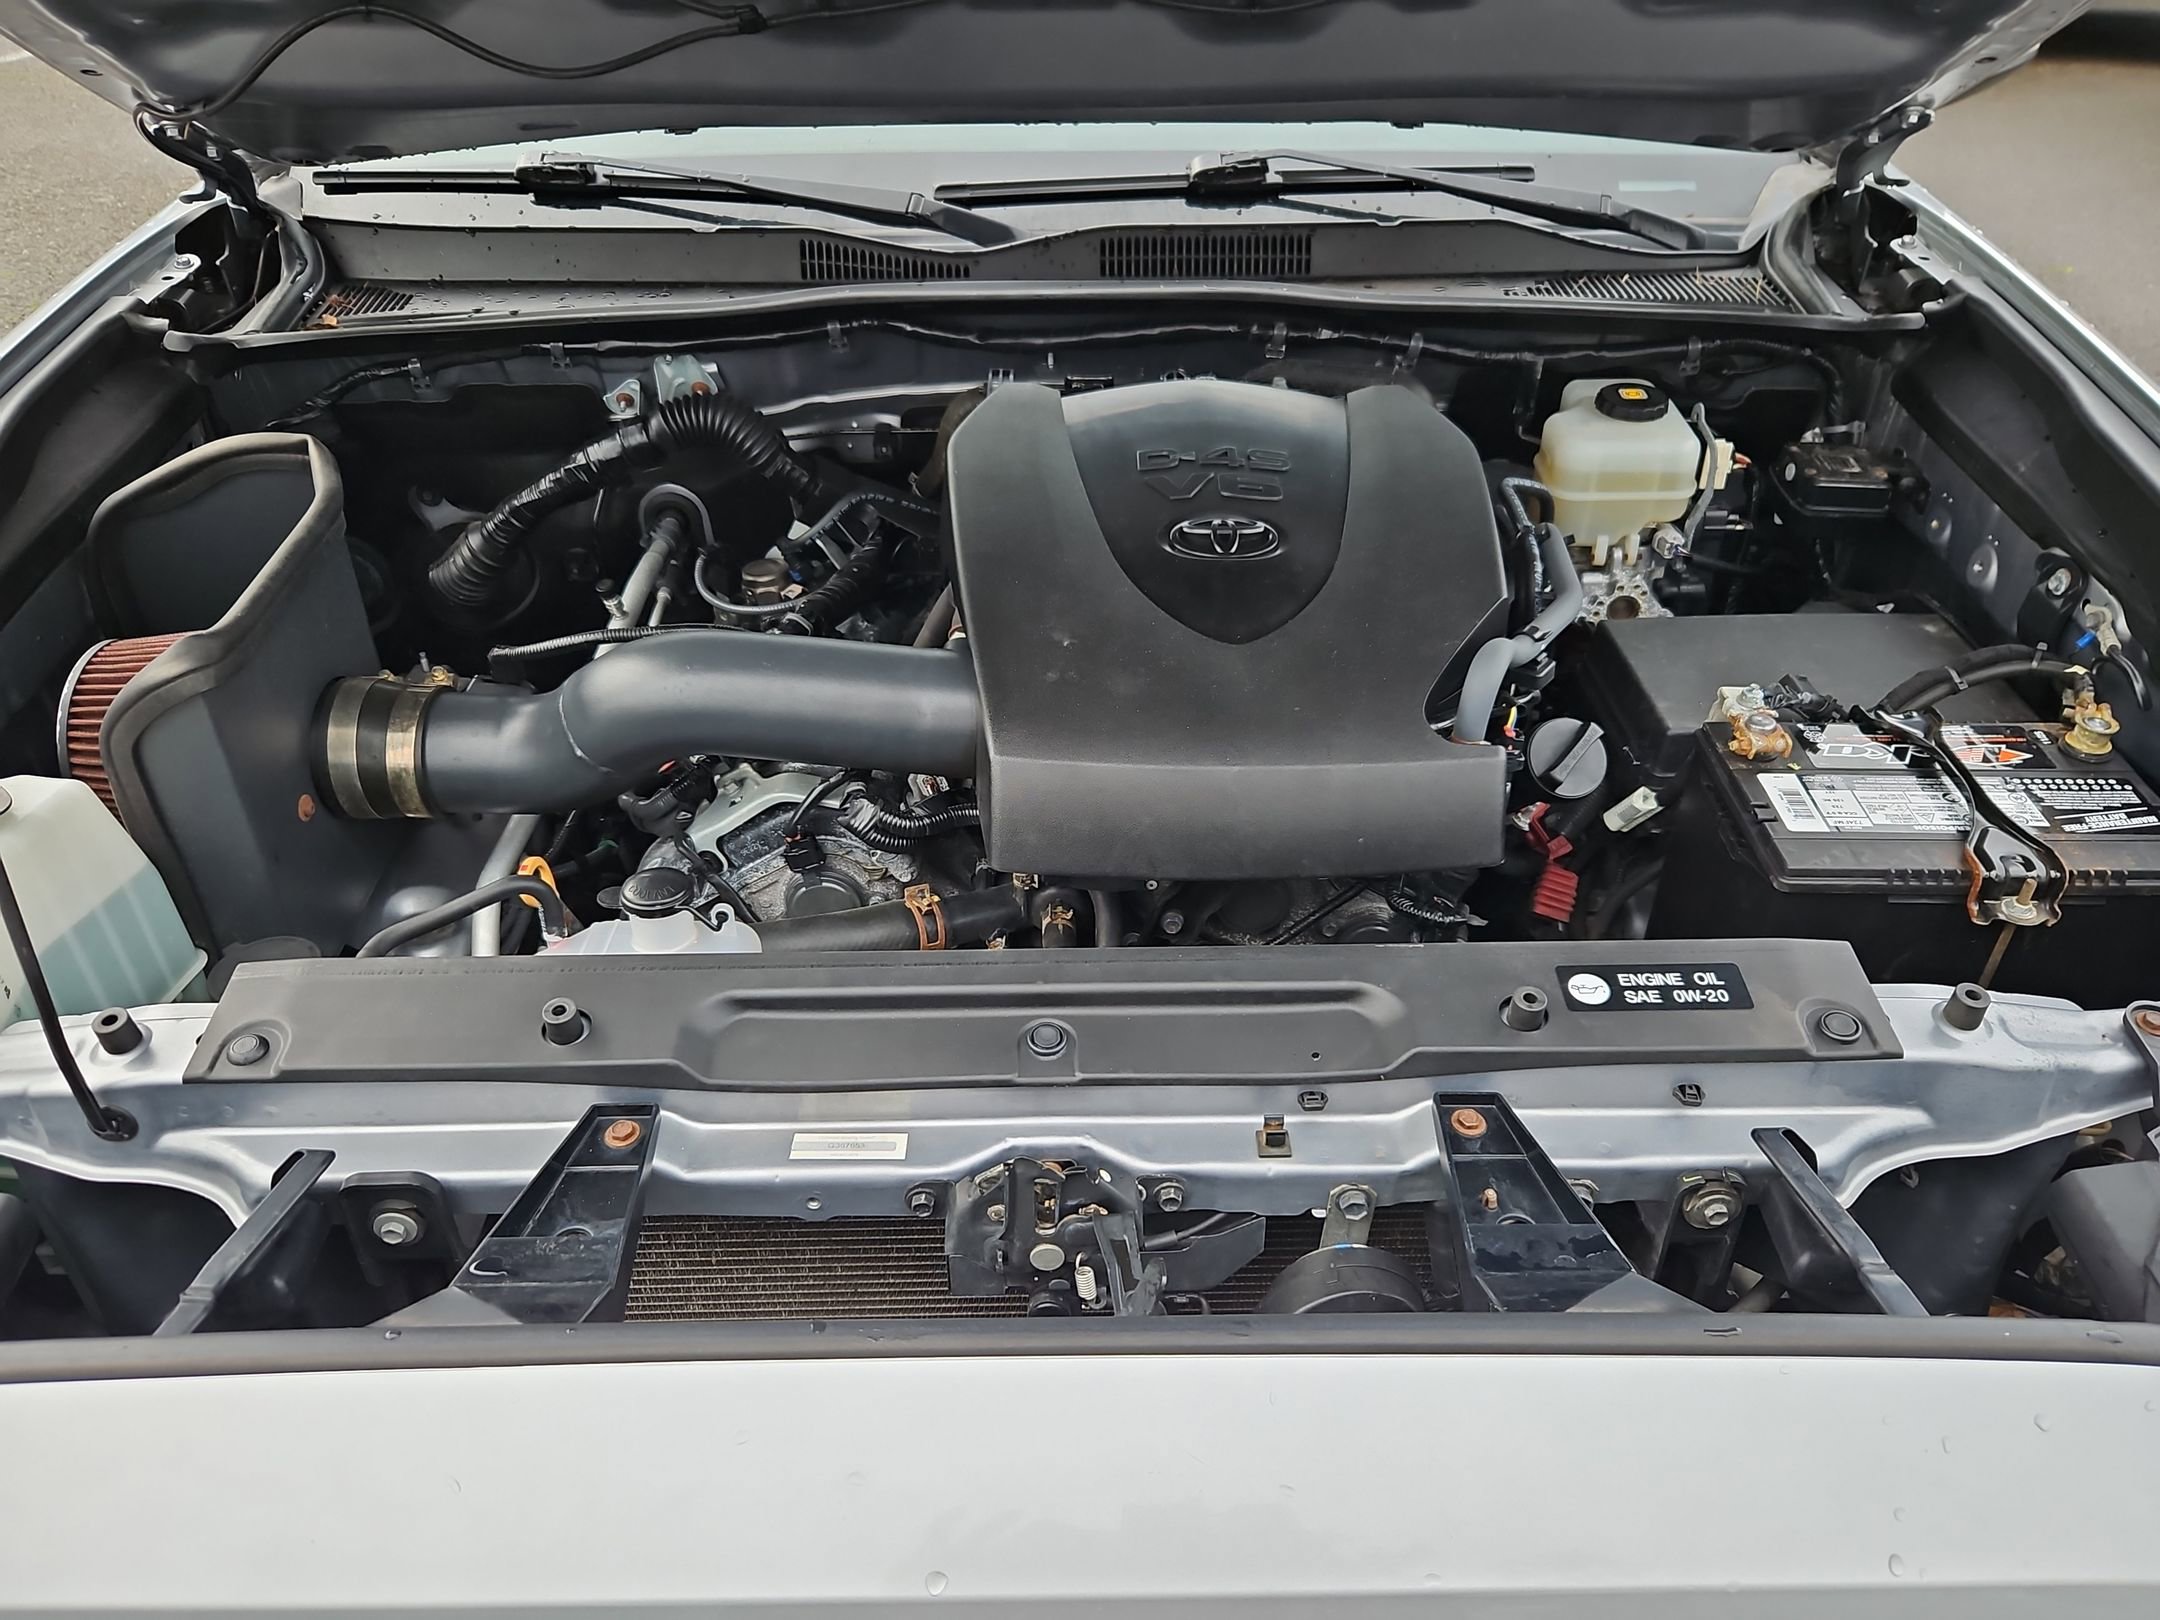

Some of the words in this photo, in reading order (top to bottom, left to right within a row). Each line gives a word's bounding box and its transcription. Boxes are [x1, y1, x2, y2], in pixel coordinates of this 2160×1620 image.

[1144, 472, 1284, 501] V6
[2061, 815, 2158, 832] MAINTENANCE-FREE
[2084, 813, 2127, 823] BATTERY
[1616, 973, 1684, 987] ENGINE
[1693, 972, 1725, 986] OIL
[1623, 990, 1664, 1004] SAE
[1673, 989, 1729, 1003] 0W-20
